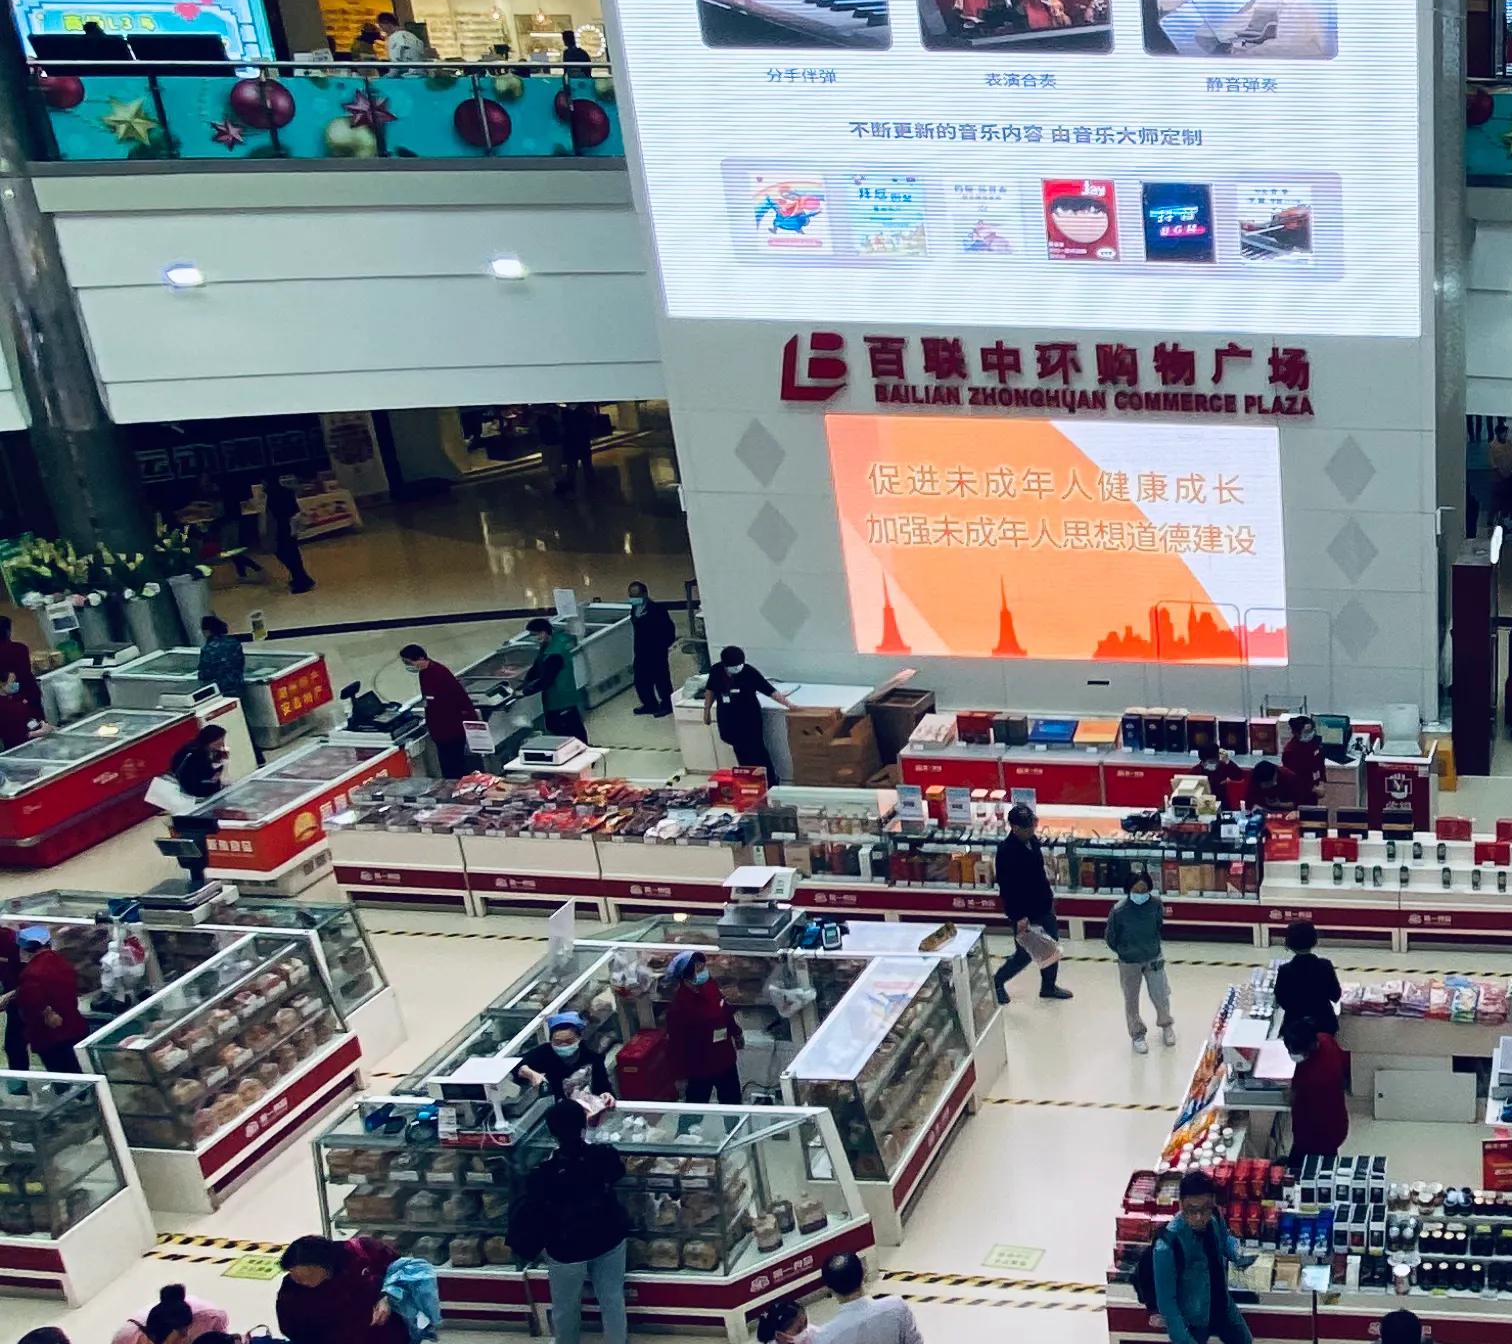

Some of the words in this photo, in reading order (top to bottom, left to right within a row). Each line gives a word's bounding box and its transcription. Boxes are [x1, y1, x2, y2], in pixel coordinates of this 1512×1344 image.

[1206, 76, 1279, 94] 静音弹奏
[849, 121, 1045, 143] 不断更新的音乐内容
[1051, 126, 1202, 147] 由音乐大师定制
[863, 335, 1311, 391] 百联中环购物广场
[874, 384, 961, 405] BAILIAN
[968, 387, 1106, 413] ZHONGHUAN
[1113, 392, 1238, 414] COMMERCE
[1244, 396, 1315, 415] PLAZA
[867, 463, 1246, 506] 促进未成年人健康成长
[866, 513, 1257, 556] 加强未成年人思想道德建设
